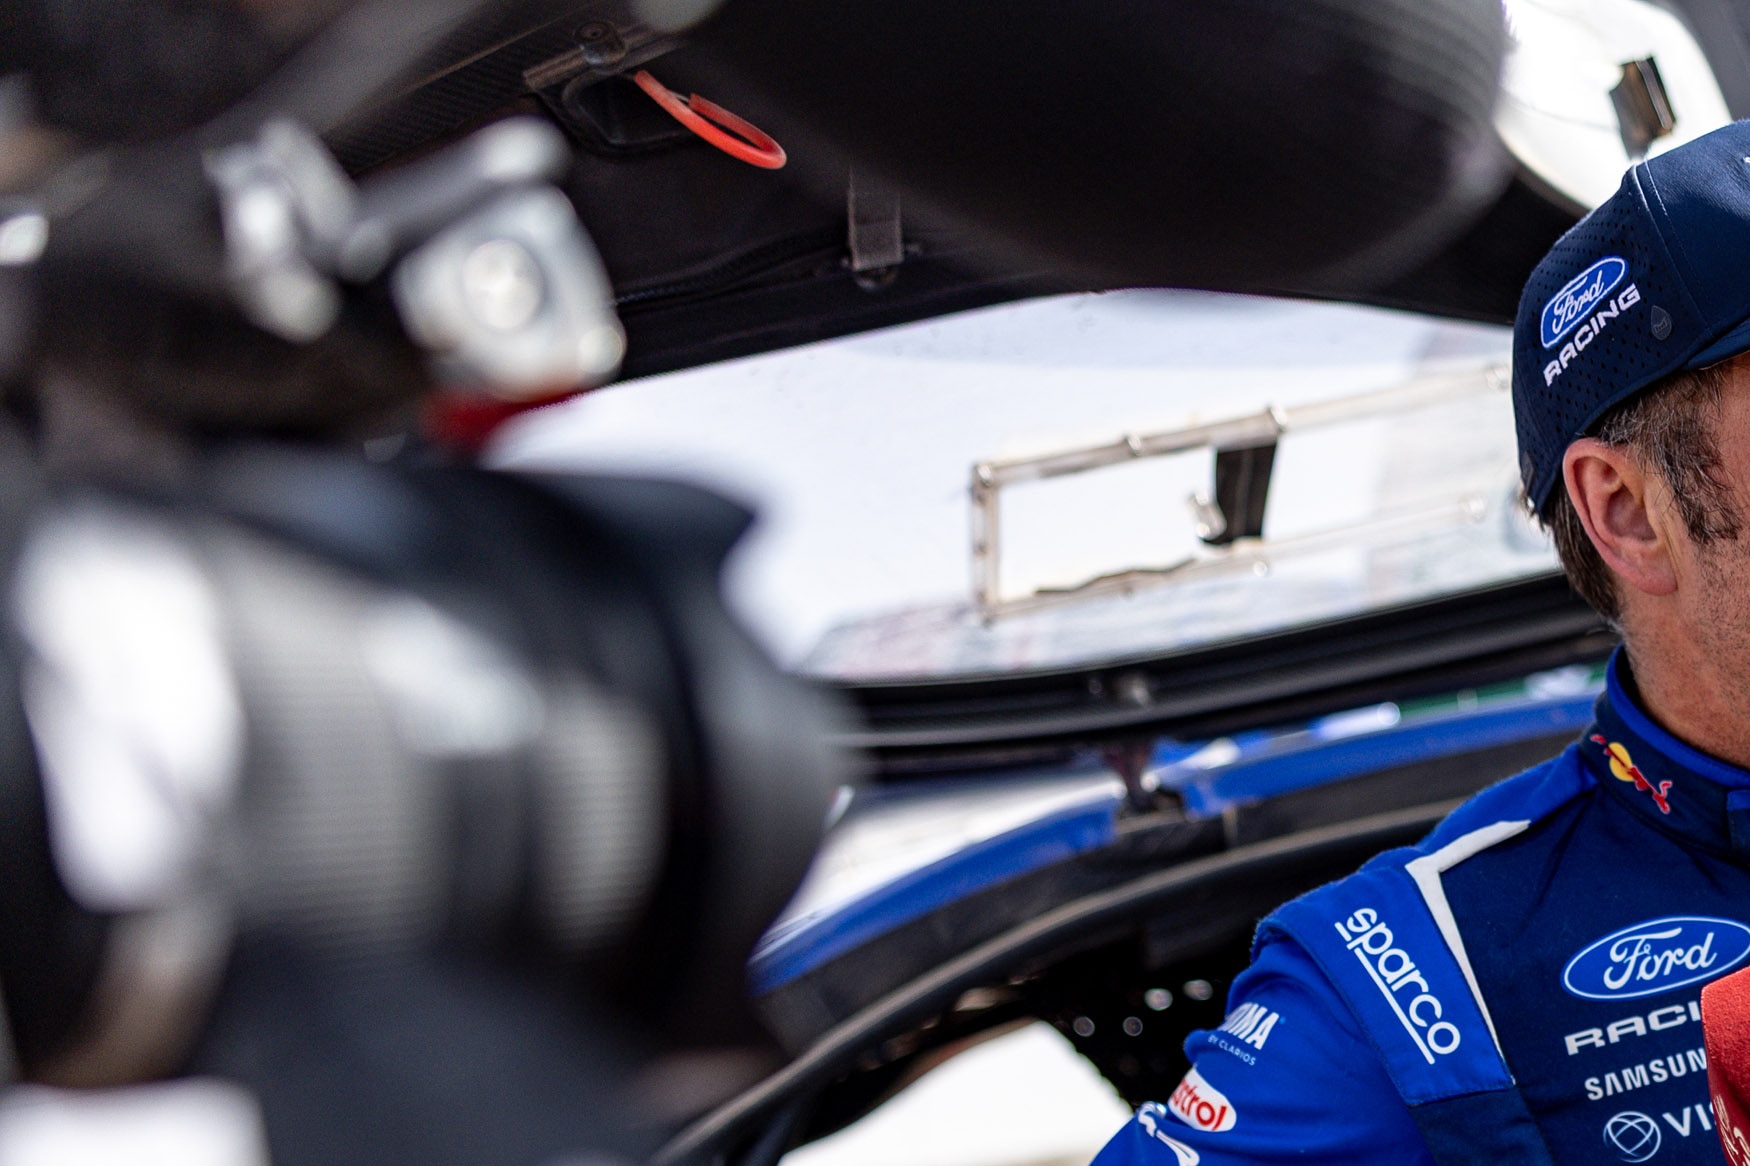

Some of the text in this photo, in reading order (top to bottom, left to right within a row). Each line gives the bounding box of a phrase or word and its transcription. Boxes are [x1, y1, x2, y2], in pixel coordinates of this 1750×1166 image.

[1543, 283, 1641, 387] RACING
[1344, 907, 1461, 1056] sparco
[1603, 926, 1718, 990] Ford
[1218, 1040, 1256, 1066] CLARIOS
[1564, 1000, 1702, 1056] RACI
[1584, 1047, 1707, 1101] SAMSUN
[1662, 1101, 1716, 1137] VI
